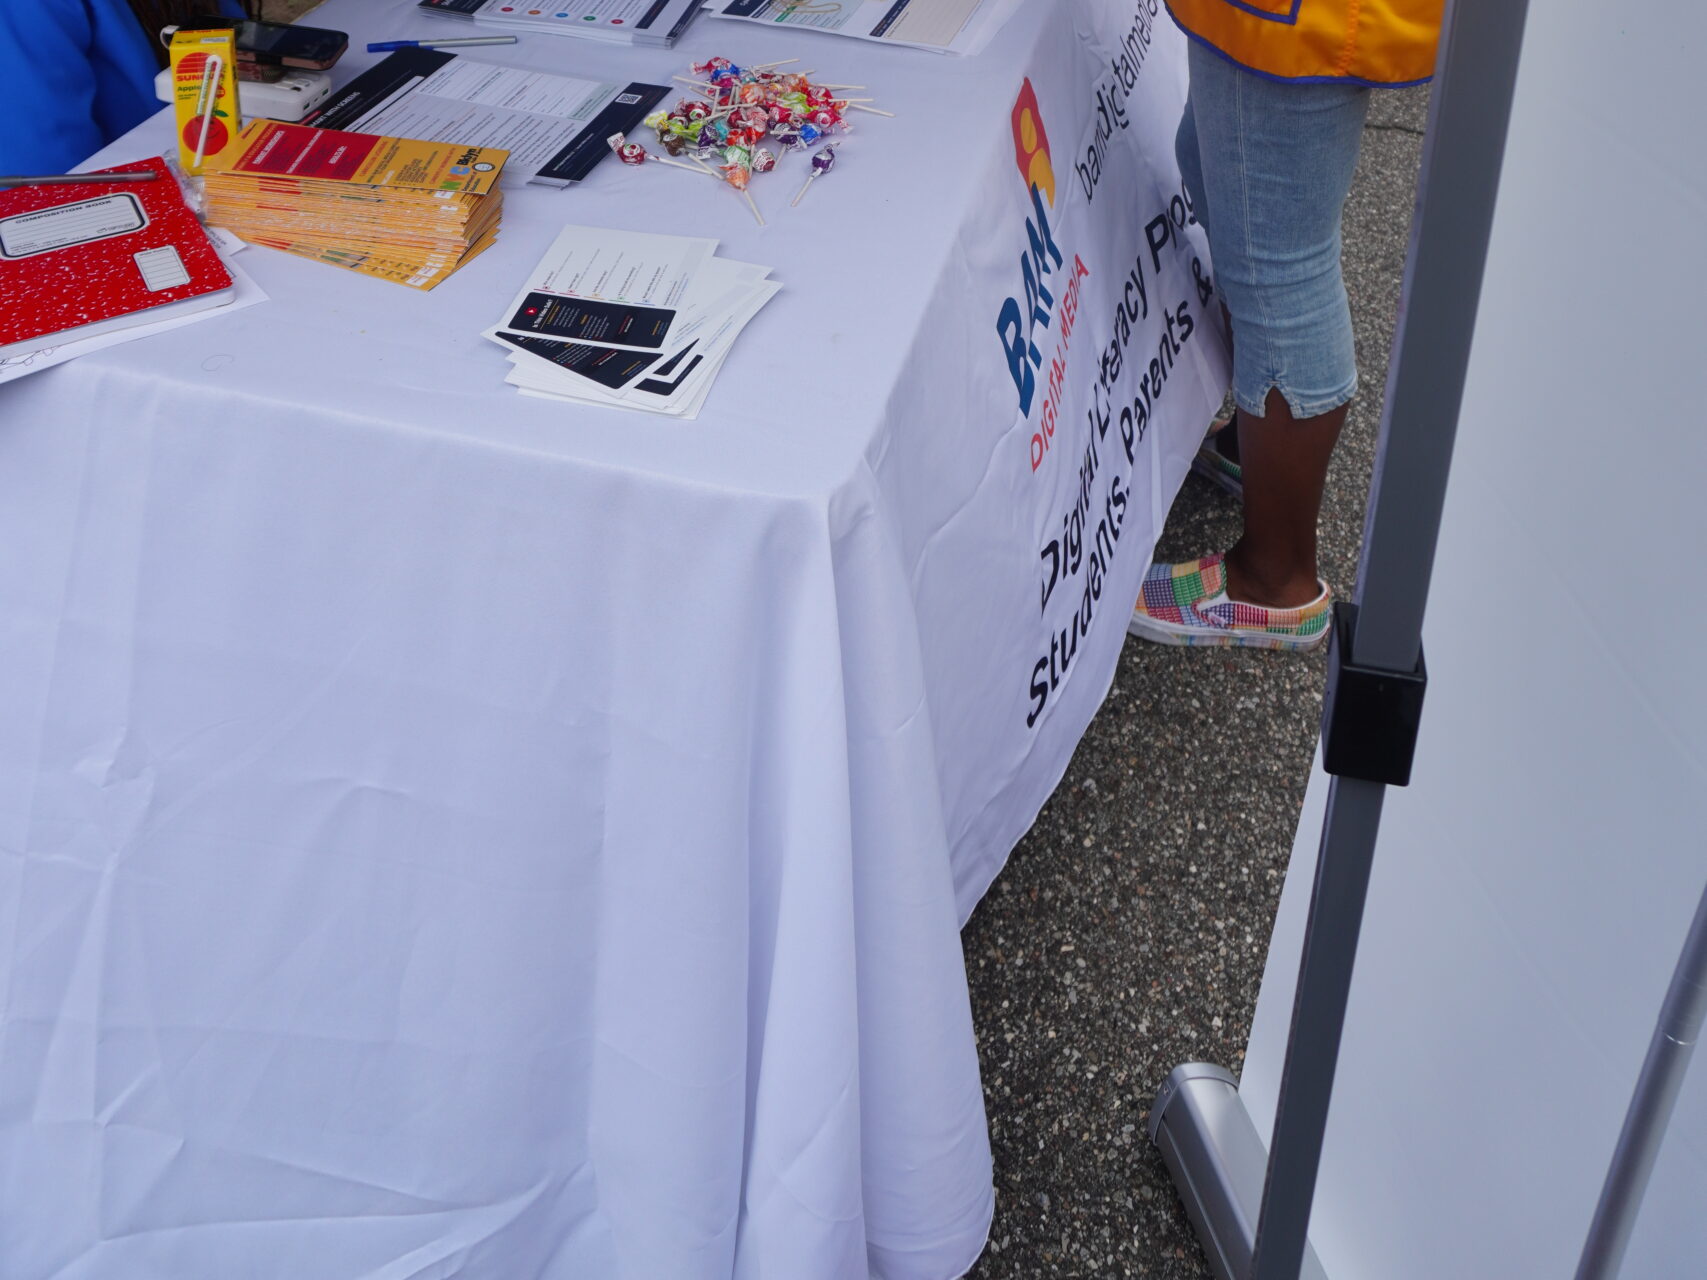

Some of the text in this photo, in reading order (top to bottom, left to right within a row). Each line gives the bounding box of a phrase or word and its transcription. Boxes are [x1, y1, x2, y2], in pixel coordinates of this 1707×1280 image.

[15, 200, 112, 224] COMPOSITION BOOK
[440, 148, 478, 190] NYC Bklyn
[997, 181, 1063, 419] BAM
[1031, 253, 1090, 472] DIGITAL MEDIA
[1120, 299, 1194, 468] Parents
[1191, 256, 1214, 308] &
[1040, 408, 1099, 619] Digital
[1093, 254, 1149, 442] Literacy
